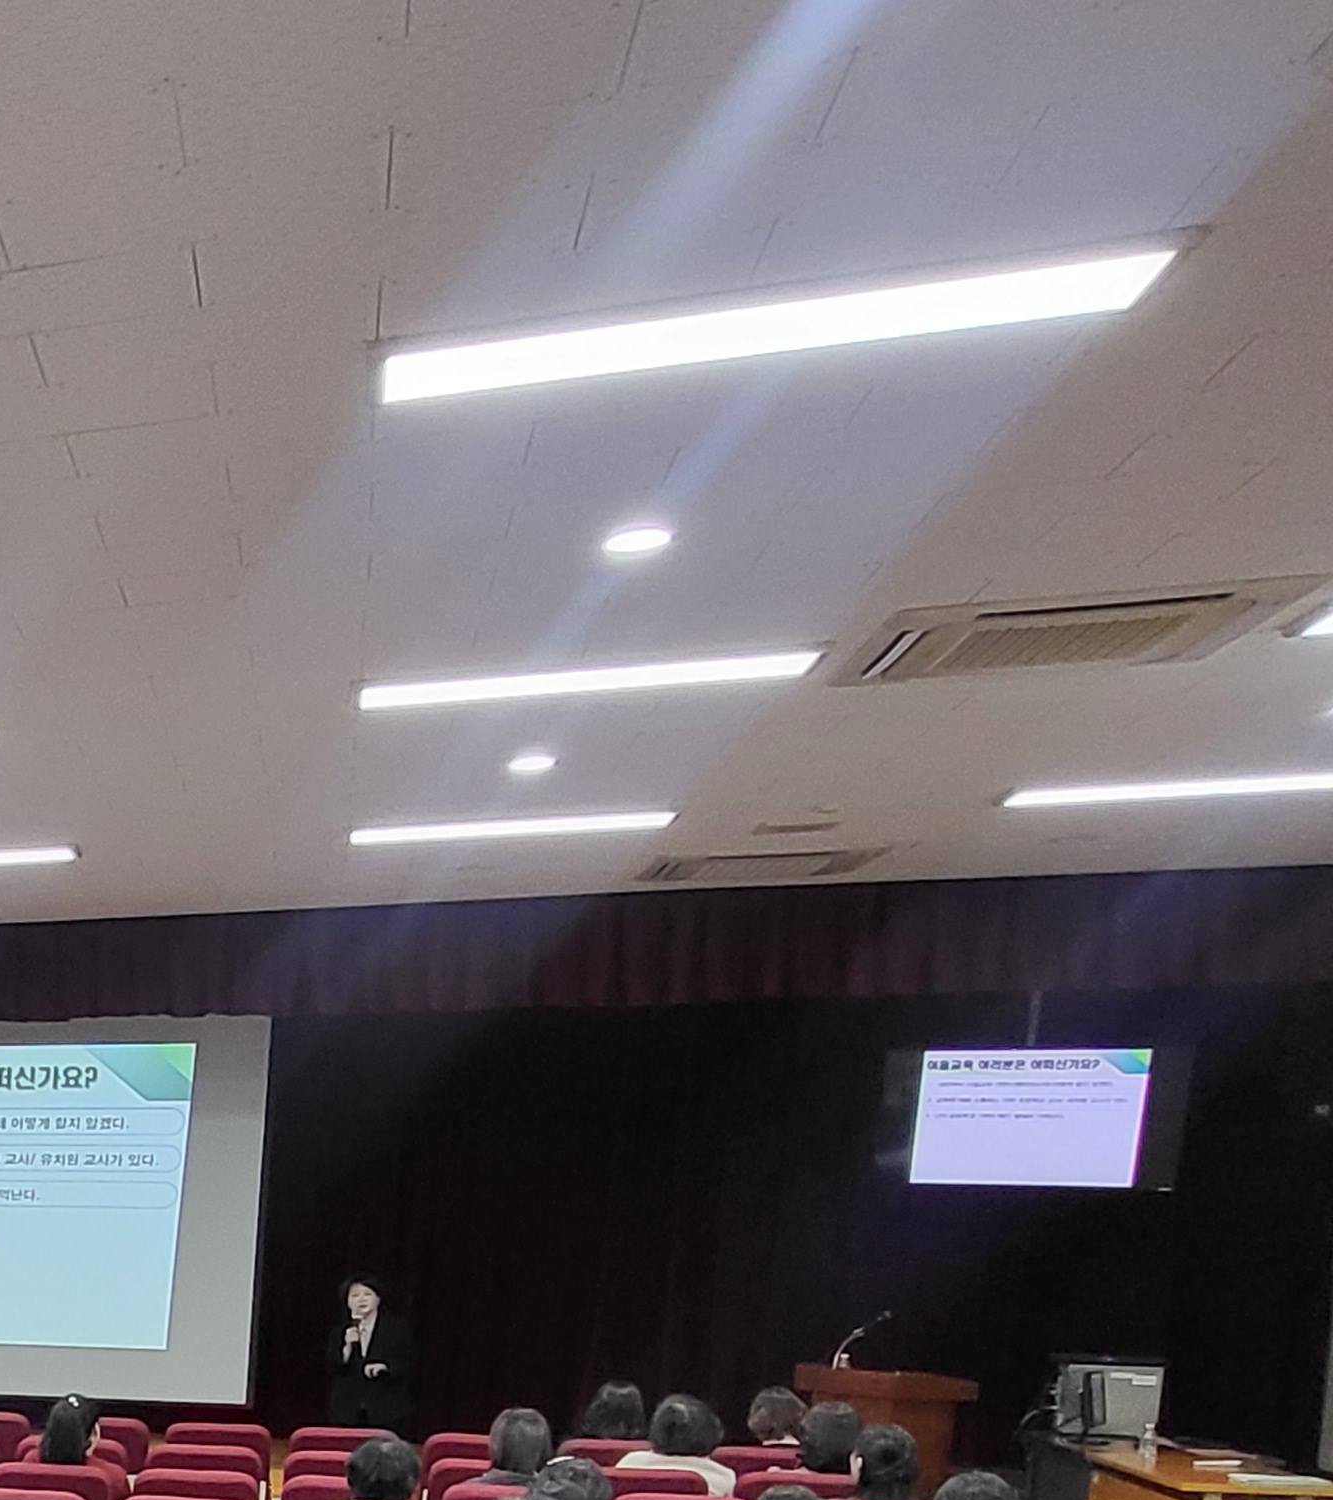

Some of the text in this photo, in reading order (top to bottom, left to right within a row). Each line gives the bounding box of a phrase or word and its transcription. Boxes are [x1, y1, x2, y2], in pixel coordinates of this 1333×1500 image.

[10, 1117, 50, 1130] 어떻게
[4, 1152, 36, 1166] 교사/
[40, 1153, 79, 1166] 유치원
[83, 1153, 123, 1167] 교사가
[127, 1153, 160, 1167] 있다.
